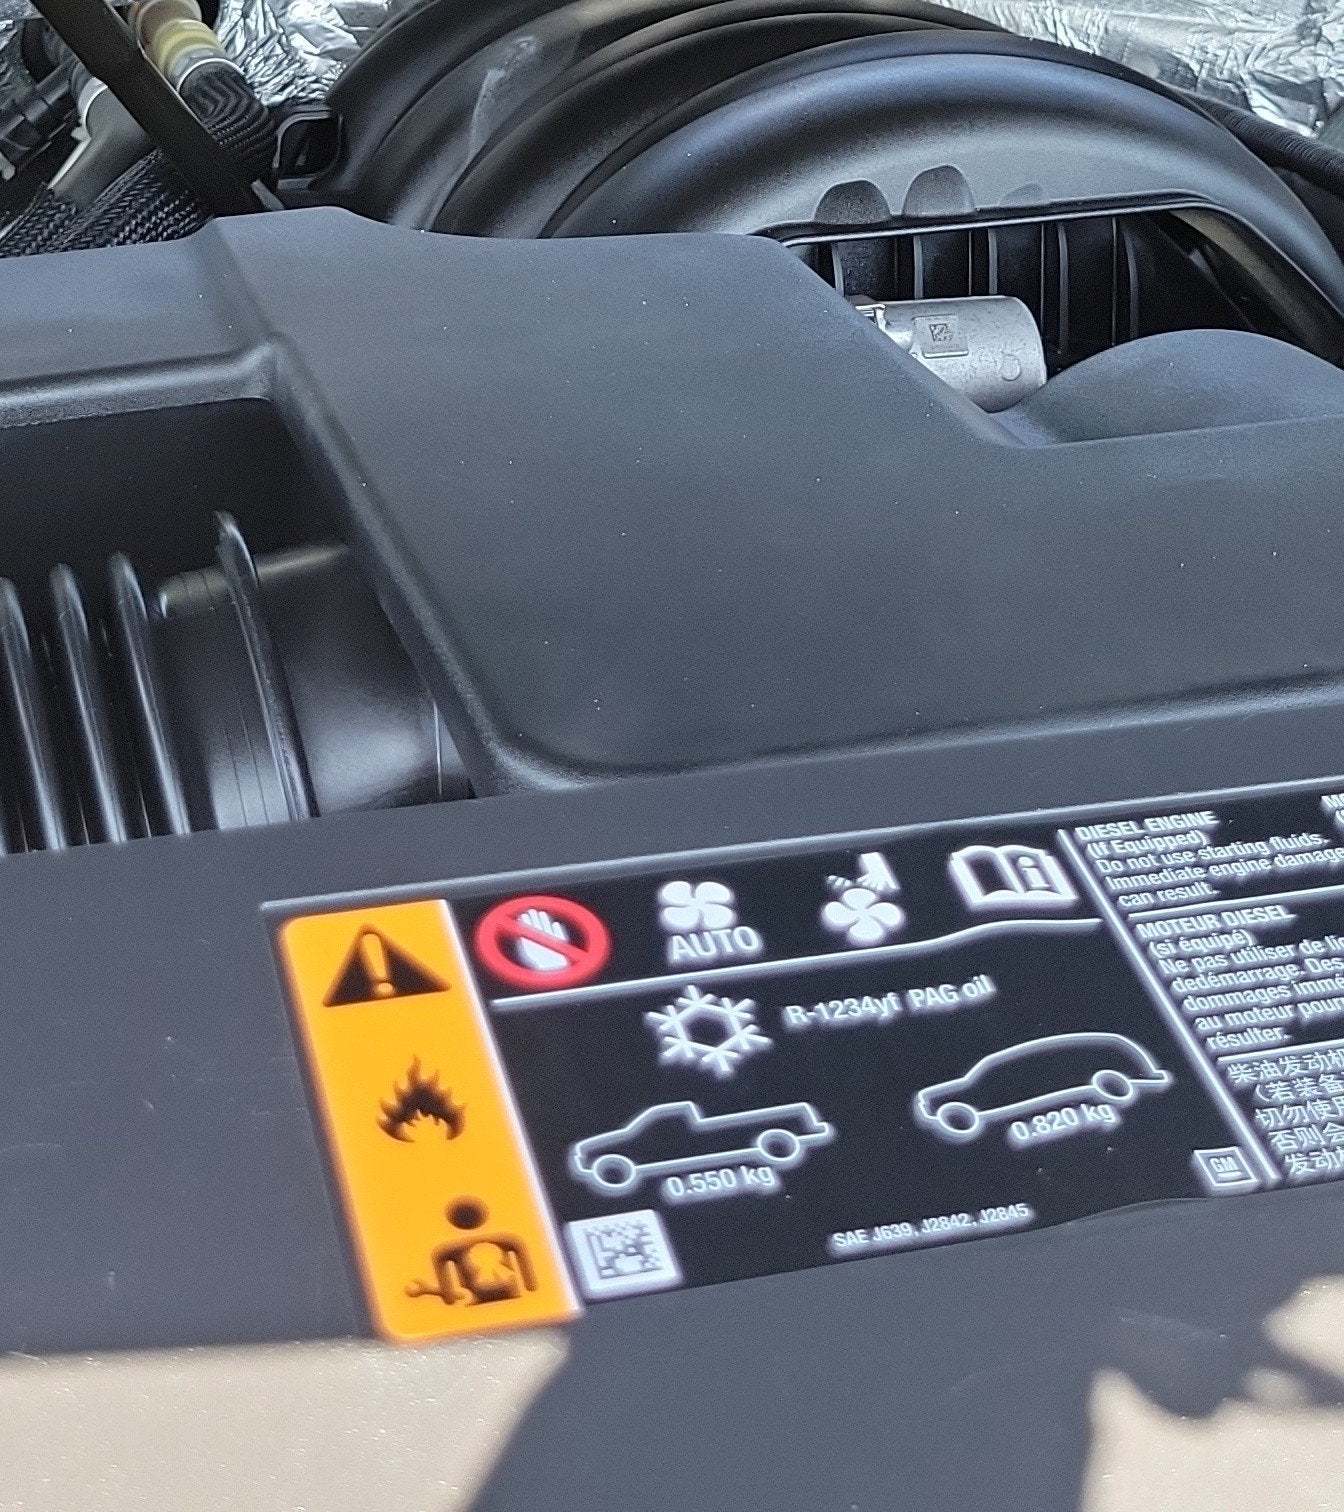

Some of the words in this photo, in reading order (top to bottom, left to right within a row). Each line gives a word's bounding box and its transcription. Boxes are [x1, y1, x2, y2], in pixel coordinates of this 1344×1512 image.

[1074, 820, 1147, 841] DIESEL
[1144, 810, 1220, 832] ENGINE
[1086, 841, 1111, 860] (If
[1110, 829, 1210, 855] Equipped)
[1094, 859, 1126, 874] Do
[1126, 853, 1161, 870] not
[1160, 850, 1197, 866] use
[1197, 841, 1272, 861] starting
[1269, 832, 1330, 851] fluids.
[1105, 866, 1208, 891] Immediate
[1208, 858, 1273, 878] engine
[1118, 892, 1156, 908] can
[1156, 881, 1219, 902] result.
[1136, 914, 1223, 939] MOTEUR
[1221, 904, 1296, 927] DIESEL
[670, 926, 761, 961] AUTO
[1148, 938, 1179, 959] (si
[1178, 929, 1256, 955] équipé)
[1158, 958, 1191, 975] Ne
[1191, 954, 1231, 973] pas
[1229, 944, 1297, 965] utiliser
[1298, 939, 1327, 955] de
[785, 990, 900, 1028] R-1234yf
[909, 983, 958, 1009] PAG
[963, 974, 995, 999] oil
[1183, 985, 1293, 1015] dommages
[1195, 1015, 1225, 1032] au
[1224, 1004, 1296, 1027] moteur
[1207, 1027, 1291, 1051] résulter.
[1011, 1107, 1078, 1140] 0.820
[1084, 1103, 1116, 1125] kg
[666, 1168, 735, 1196] 0.550
[741, 1164, 776, 1189] kg
[1209, 1156, 1239, 1172] GM
[833, 1230, 869, 1248] SAE
[872, 1221, 918, 1241] J639,
[922, 1214, 975, 1236] J2842,
[980, 1204, 1029, 1224] J2845
